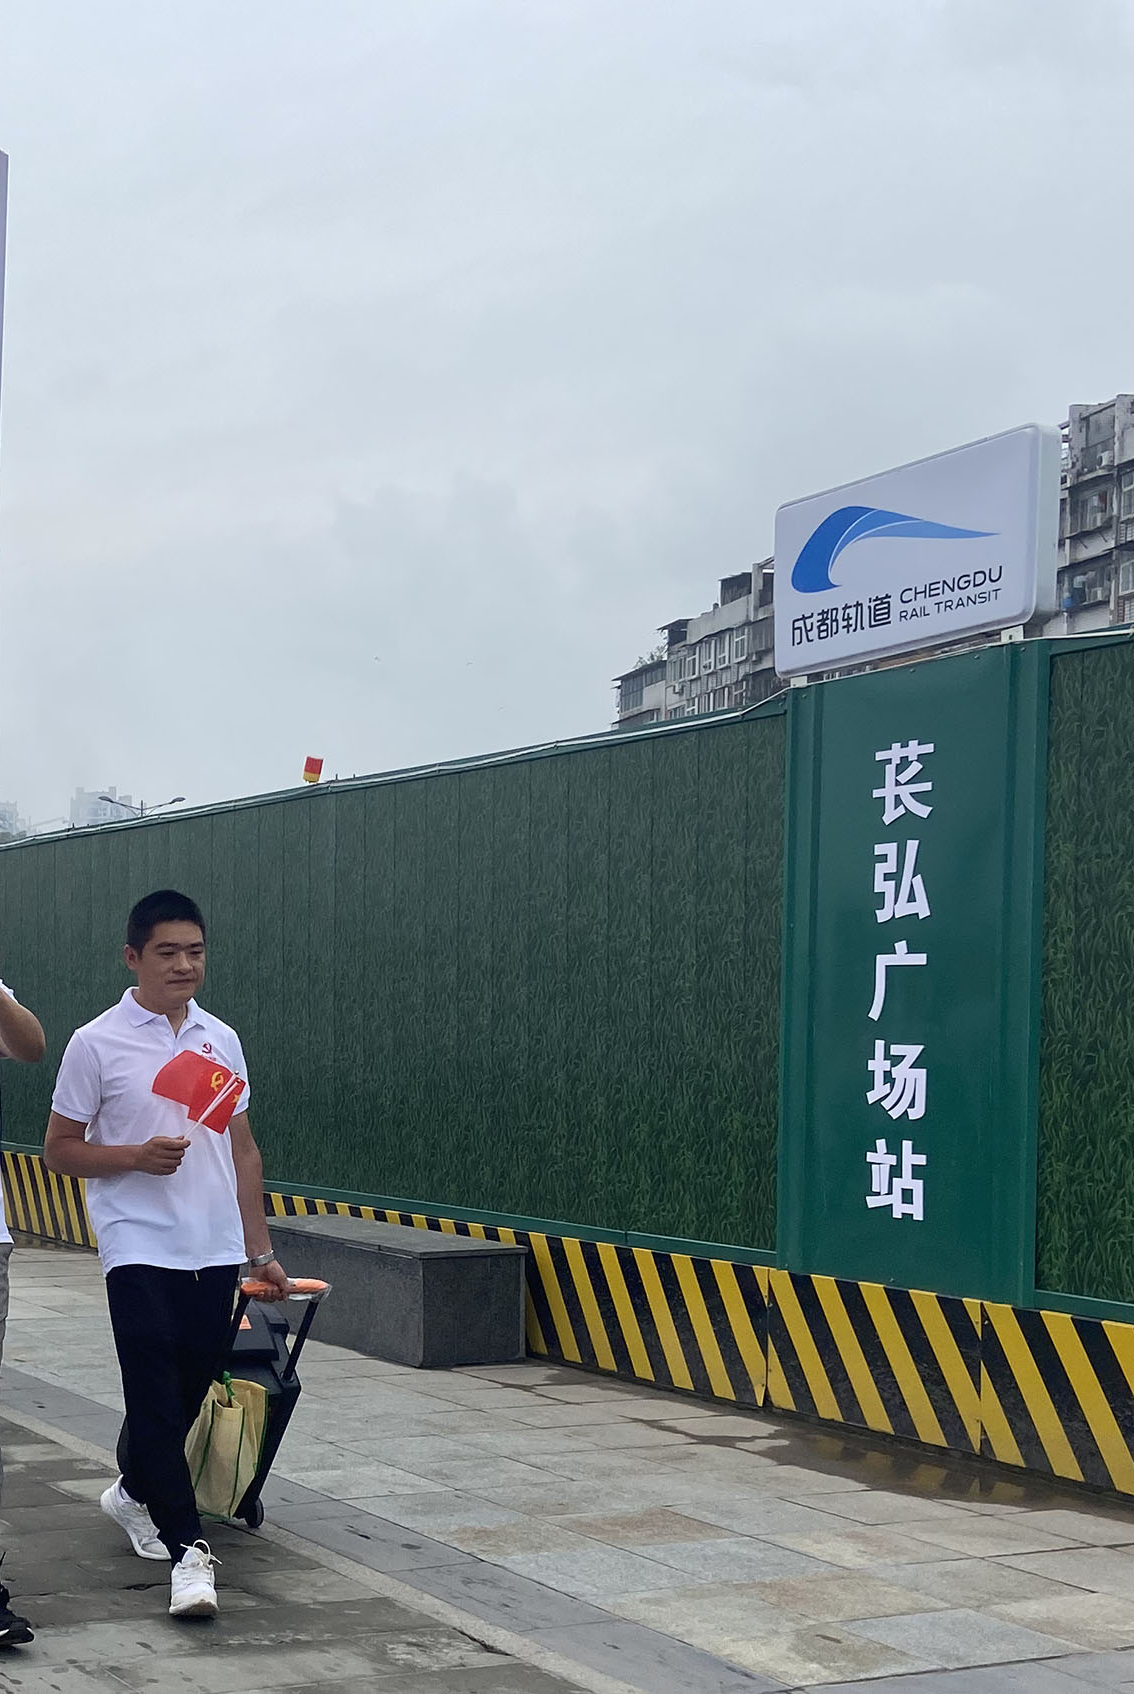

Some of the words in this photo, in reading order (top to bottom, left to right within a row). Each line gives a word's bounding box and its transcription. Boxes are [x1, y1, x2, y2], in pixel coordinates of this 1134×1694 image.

[899, 606, 930, 622] RAIL
[934, 588, 1002, 613] TRANSIT
[900, 565, 1002, 604] CHENGDU
[792, 593, 892, 646] 成都轨道
[866, 740, 935, 1221] 苌弘广场站
